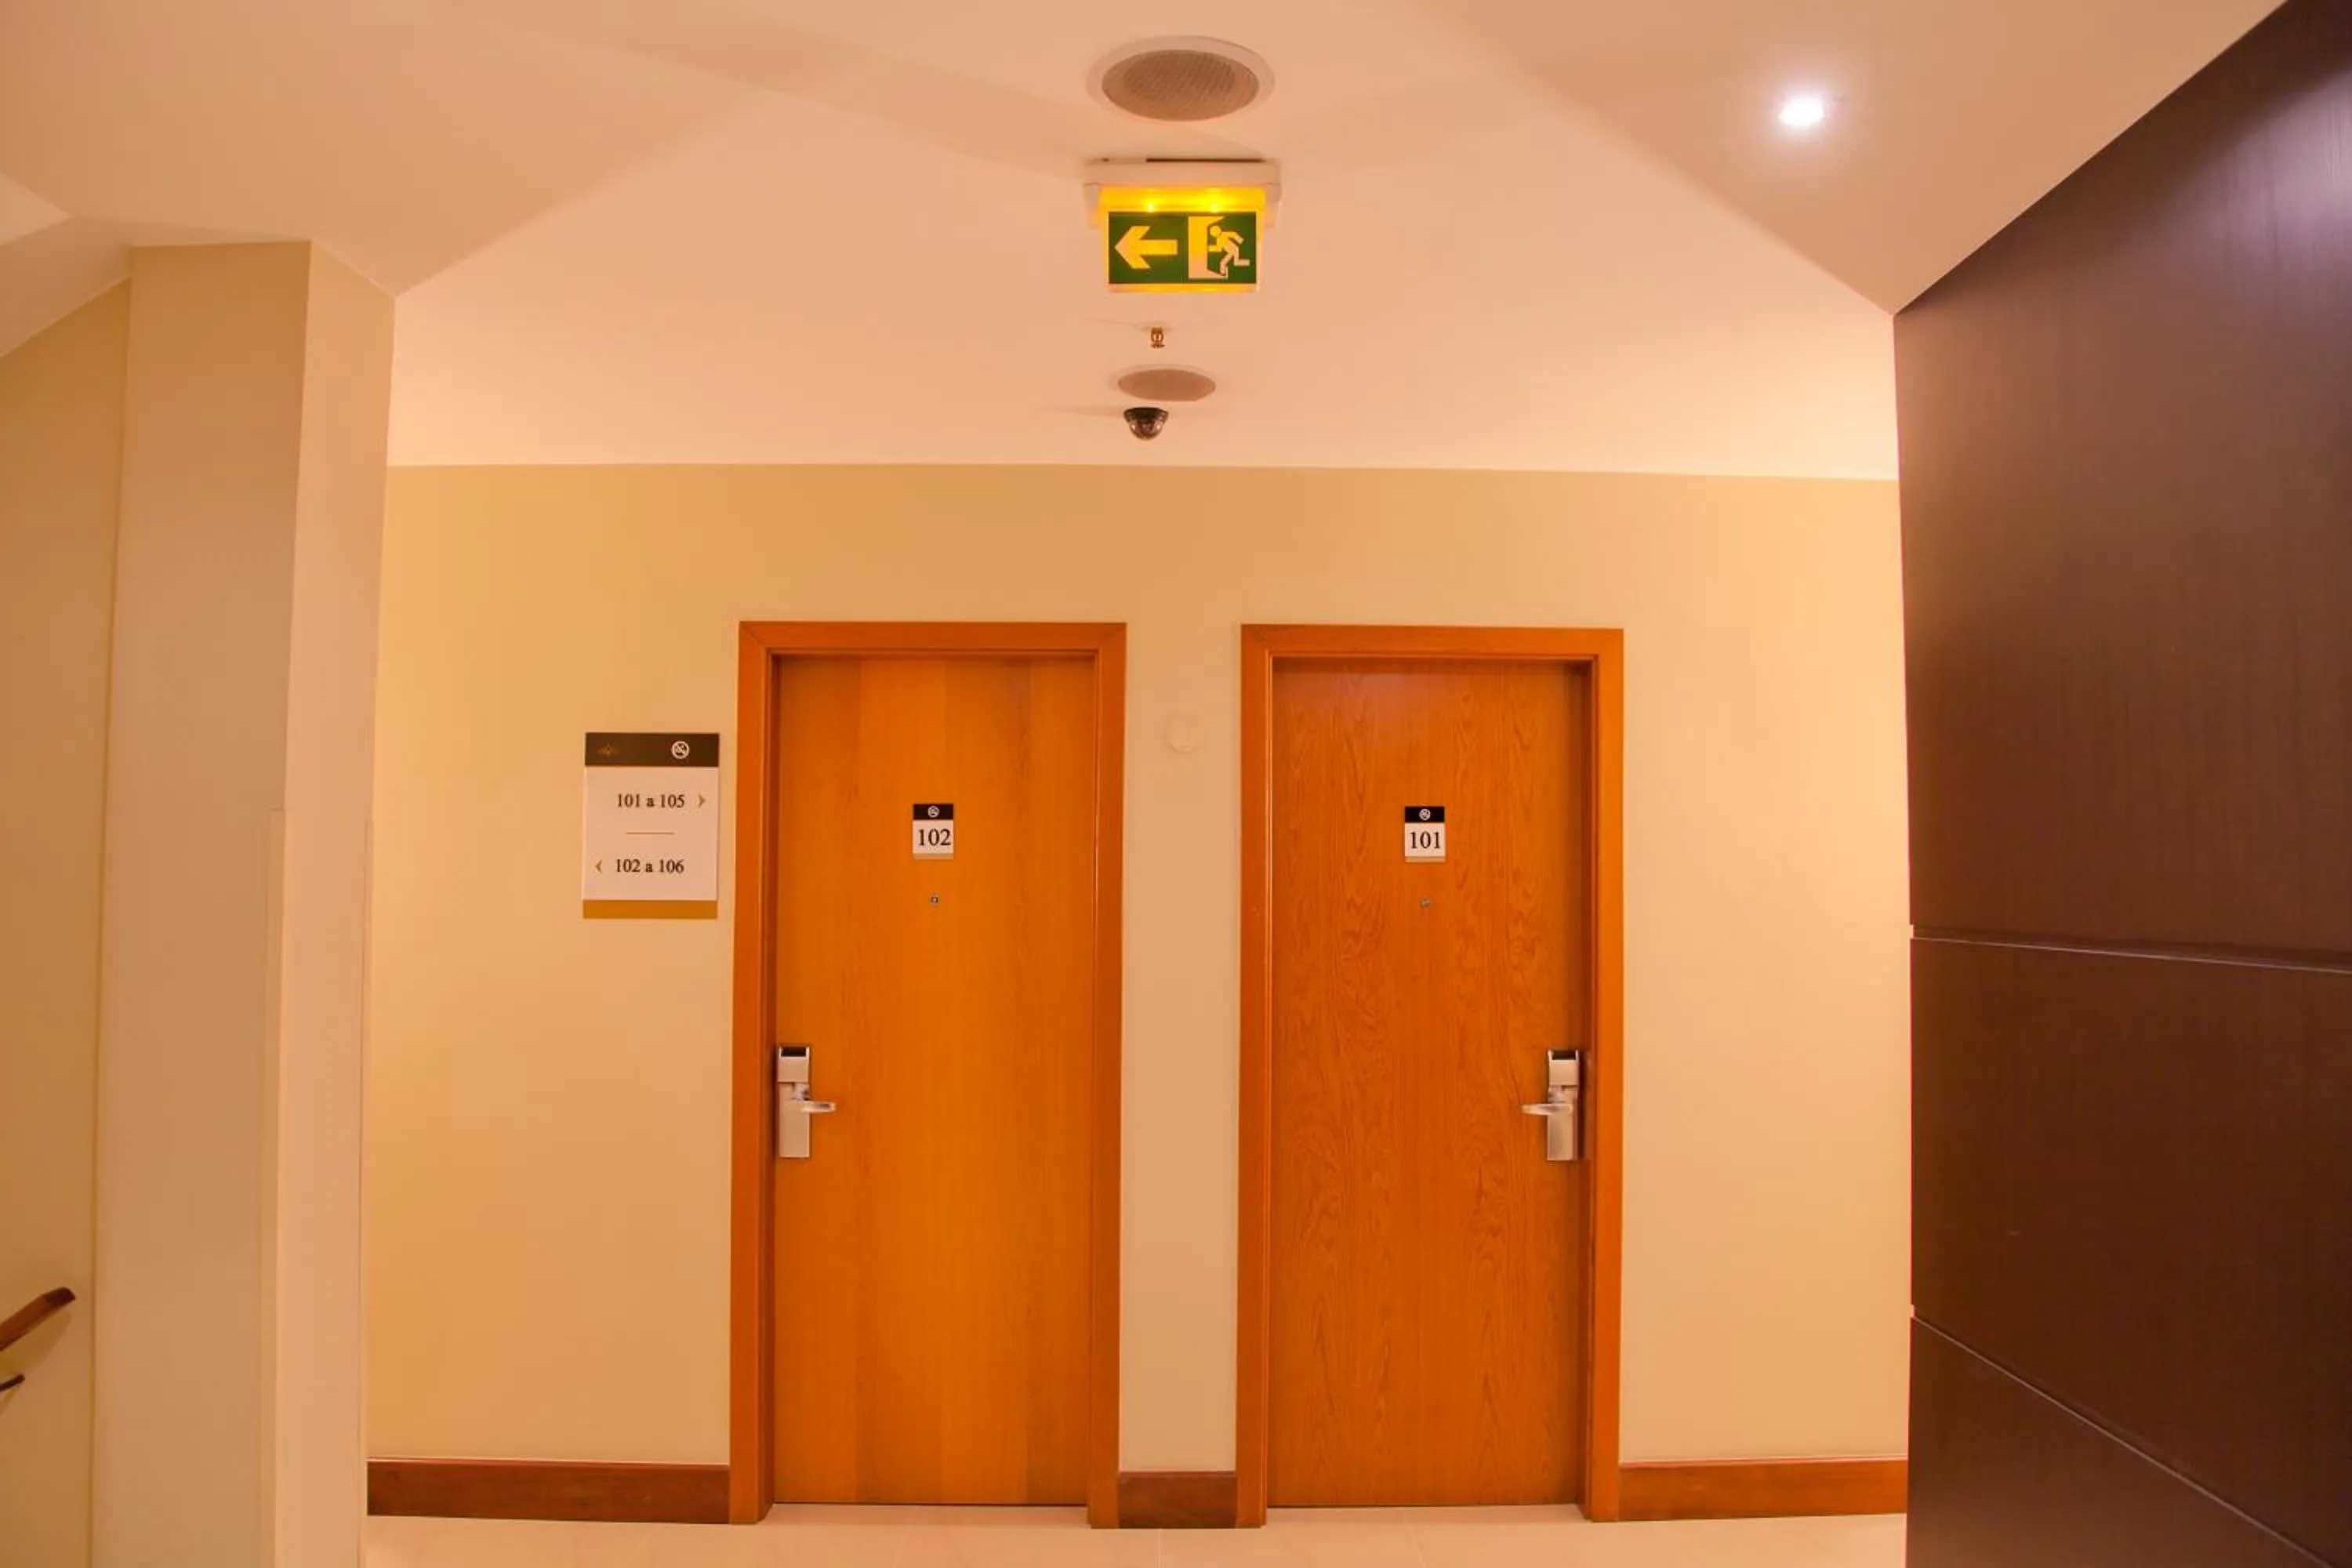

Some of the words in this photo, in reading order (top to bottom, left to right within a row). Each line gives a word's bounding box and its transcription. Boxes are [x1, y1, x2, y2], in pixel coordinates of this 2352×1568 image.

[616, 793, 641, 808] 101
[646, 797, 655, 808] a
[661, 793, 685, 808] 105
[918, 828, 951, 846] 102
[1410, 831, 1440, 849] 101
[615, 858, 641, 873] 102
[645, 862, 653, 873] a
[659, 859, 684, 873] 106
